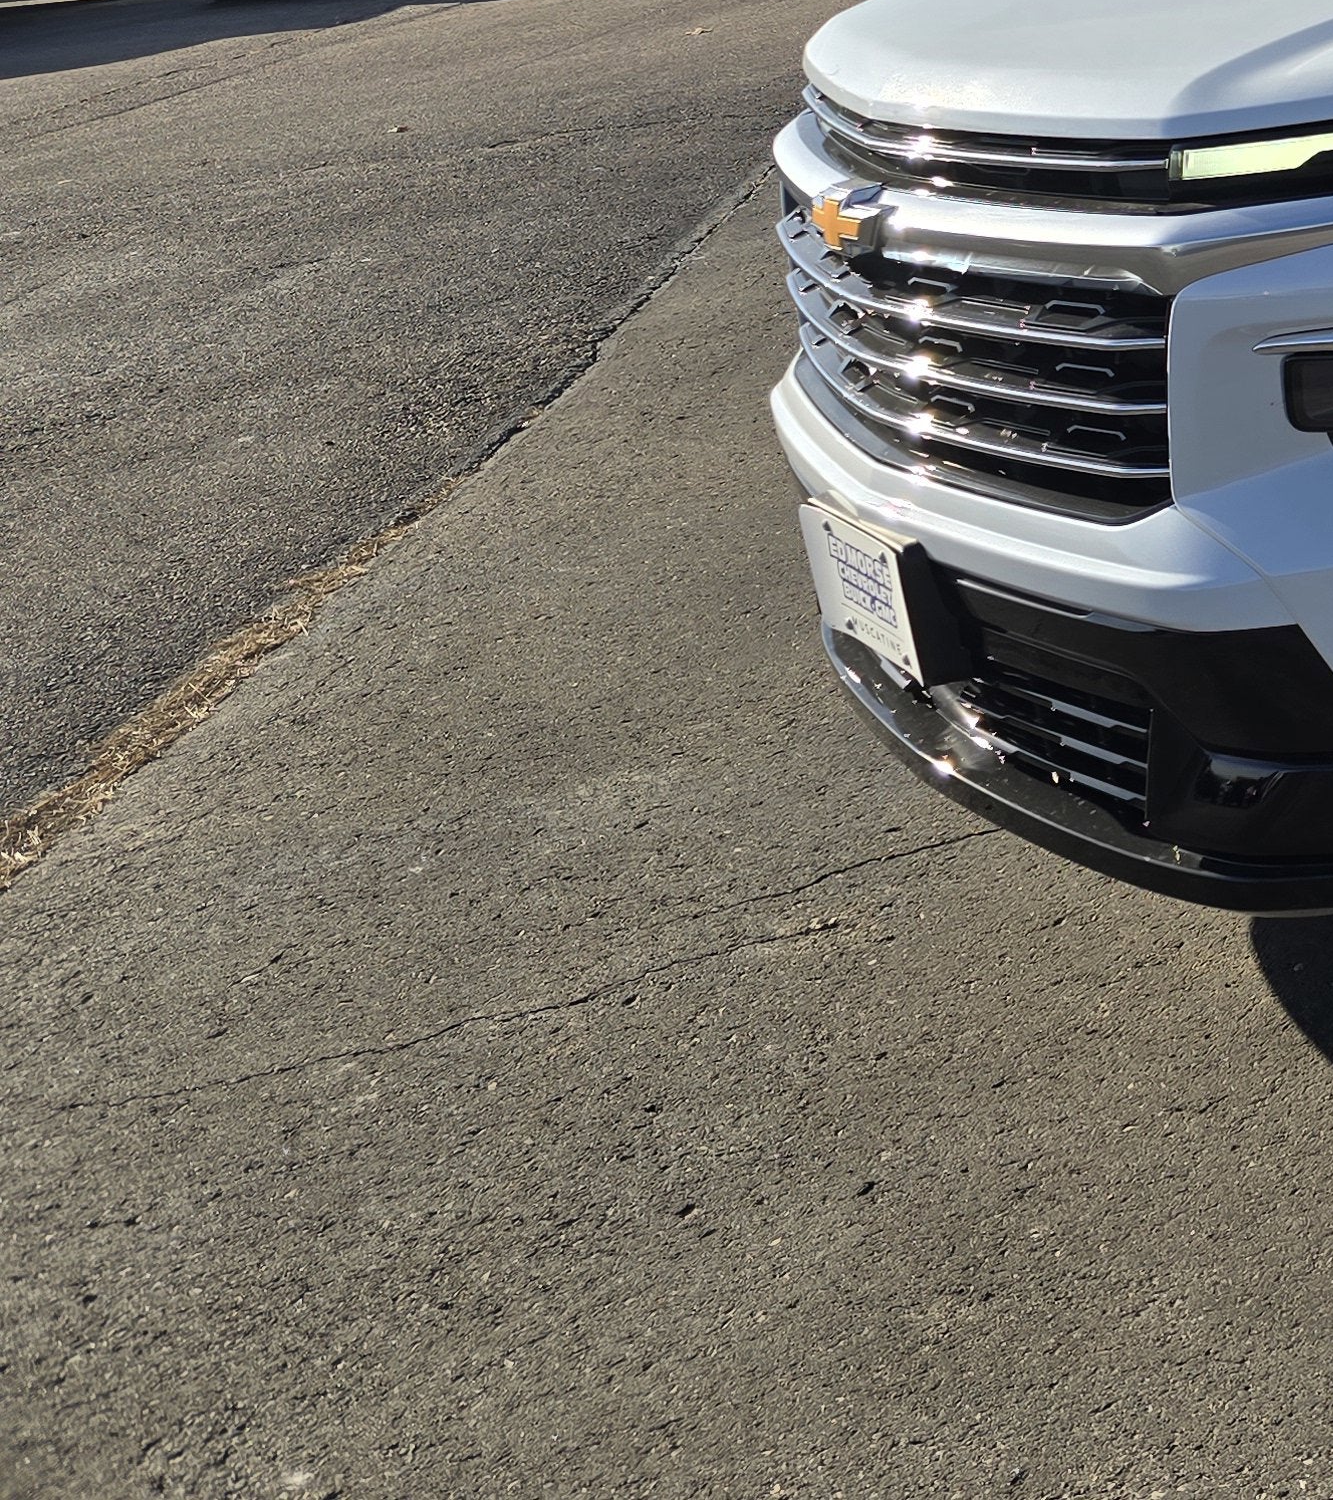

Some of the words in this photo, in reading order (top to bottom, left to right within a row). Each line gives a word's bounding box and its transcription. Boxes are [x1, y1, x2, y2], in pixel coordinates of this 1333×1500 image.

[827, 533, 847, 563] ED
[845, 543, 892, 592] MORSE
[837, 560, 893, 608] CHEVROLET
[842, 580, 875, 615] BUICK
